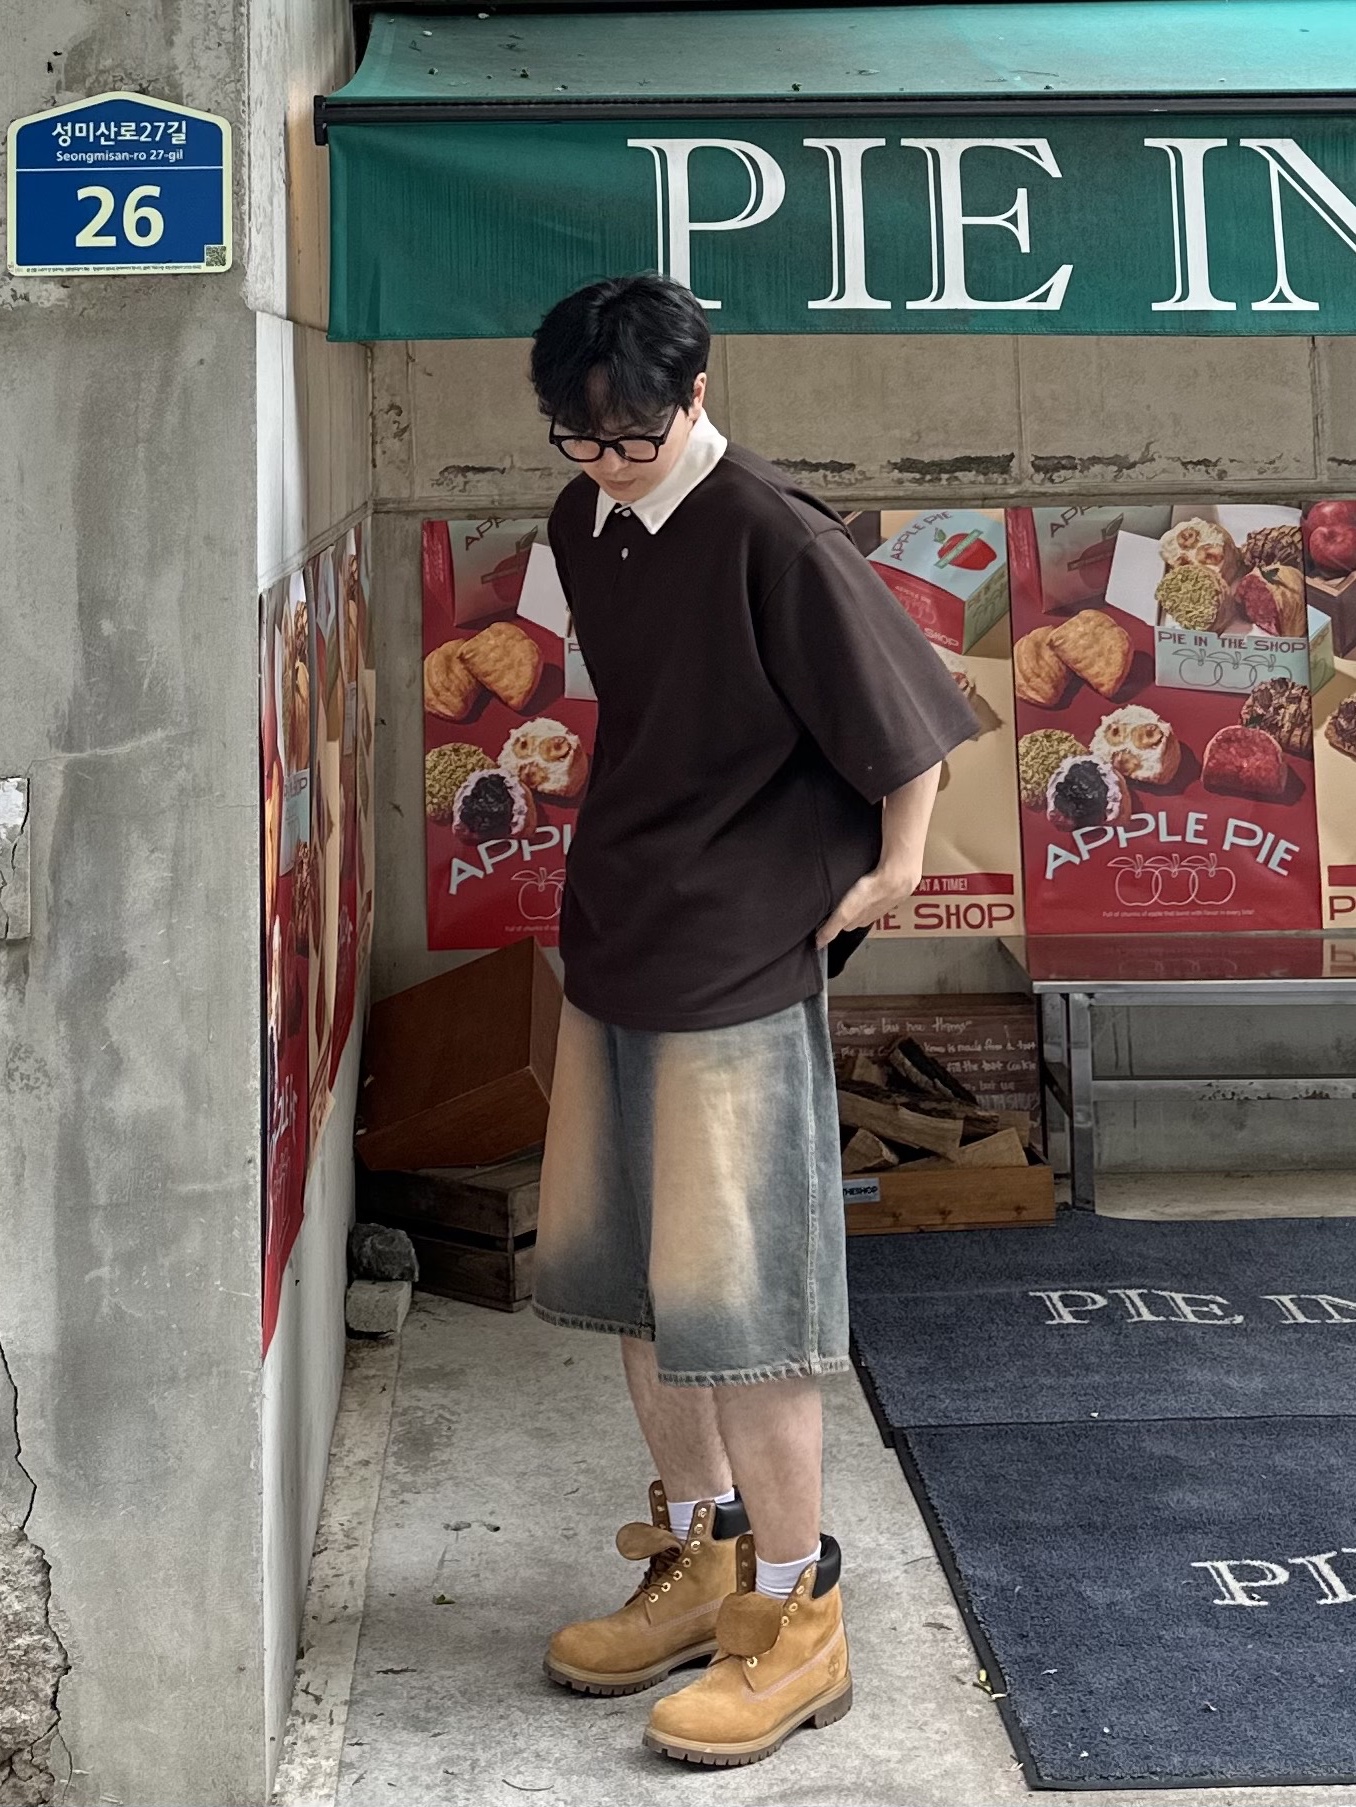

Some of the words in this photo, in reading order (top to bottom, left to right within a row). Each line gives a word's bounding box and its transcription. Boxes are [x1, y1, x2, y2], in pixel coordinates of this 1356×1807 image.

[52, 120, 187, 147] 성미산로27길
[56, 150, 147, 164] Seongmisan-ro
[150, 149, 184, 164] 27-gil
[75, 184, 164, 247] 26
[627, 137, 1074, 310] PIE
[890, 523, 926, 561] APPLE
[923, 511, 953, 526] PIE
[1158, 631, 1187, 645] PIE
[1194, 636, 1208, 647] IN
[1219, 637, 1248, 650] THE
[1254, 639, 1307, 654] SHOP
[1045, 811, 1208, 880] APPLE
[1222, 818, 1300, 877] PIE
[920, 878, 930, 891] AT
[933, 878, 941, 891] A
[913, 902, 1015, 930] SHOP
[1028, 1288, 1245, 1325] PIE
[1191, 1548, 1356, 1606] PI
